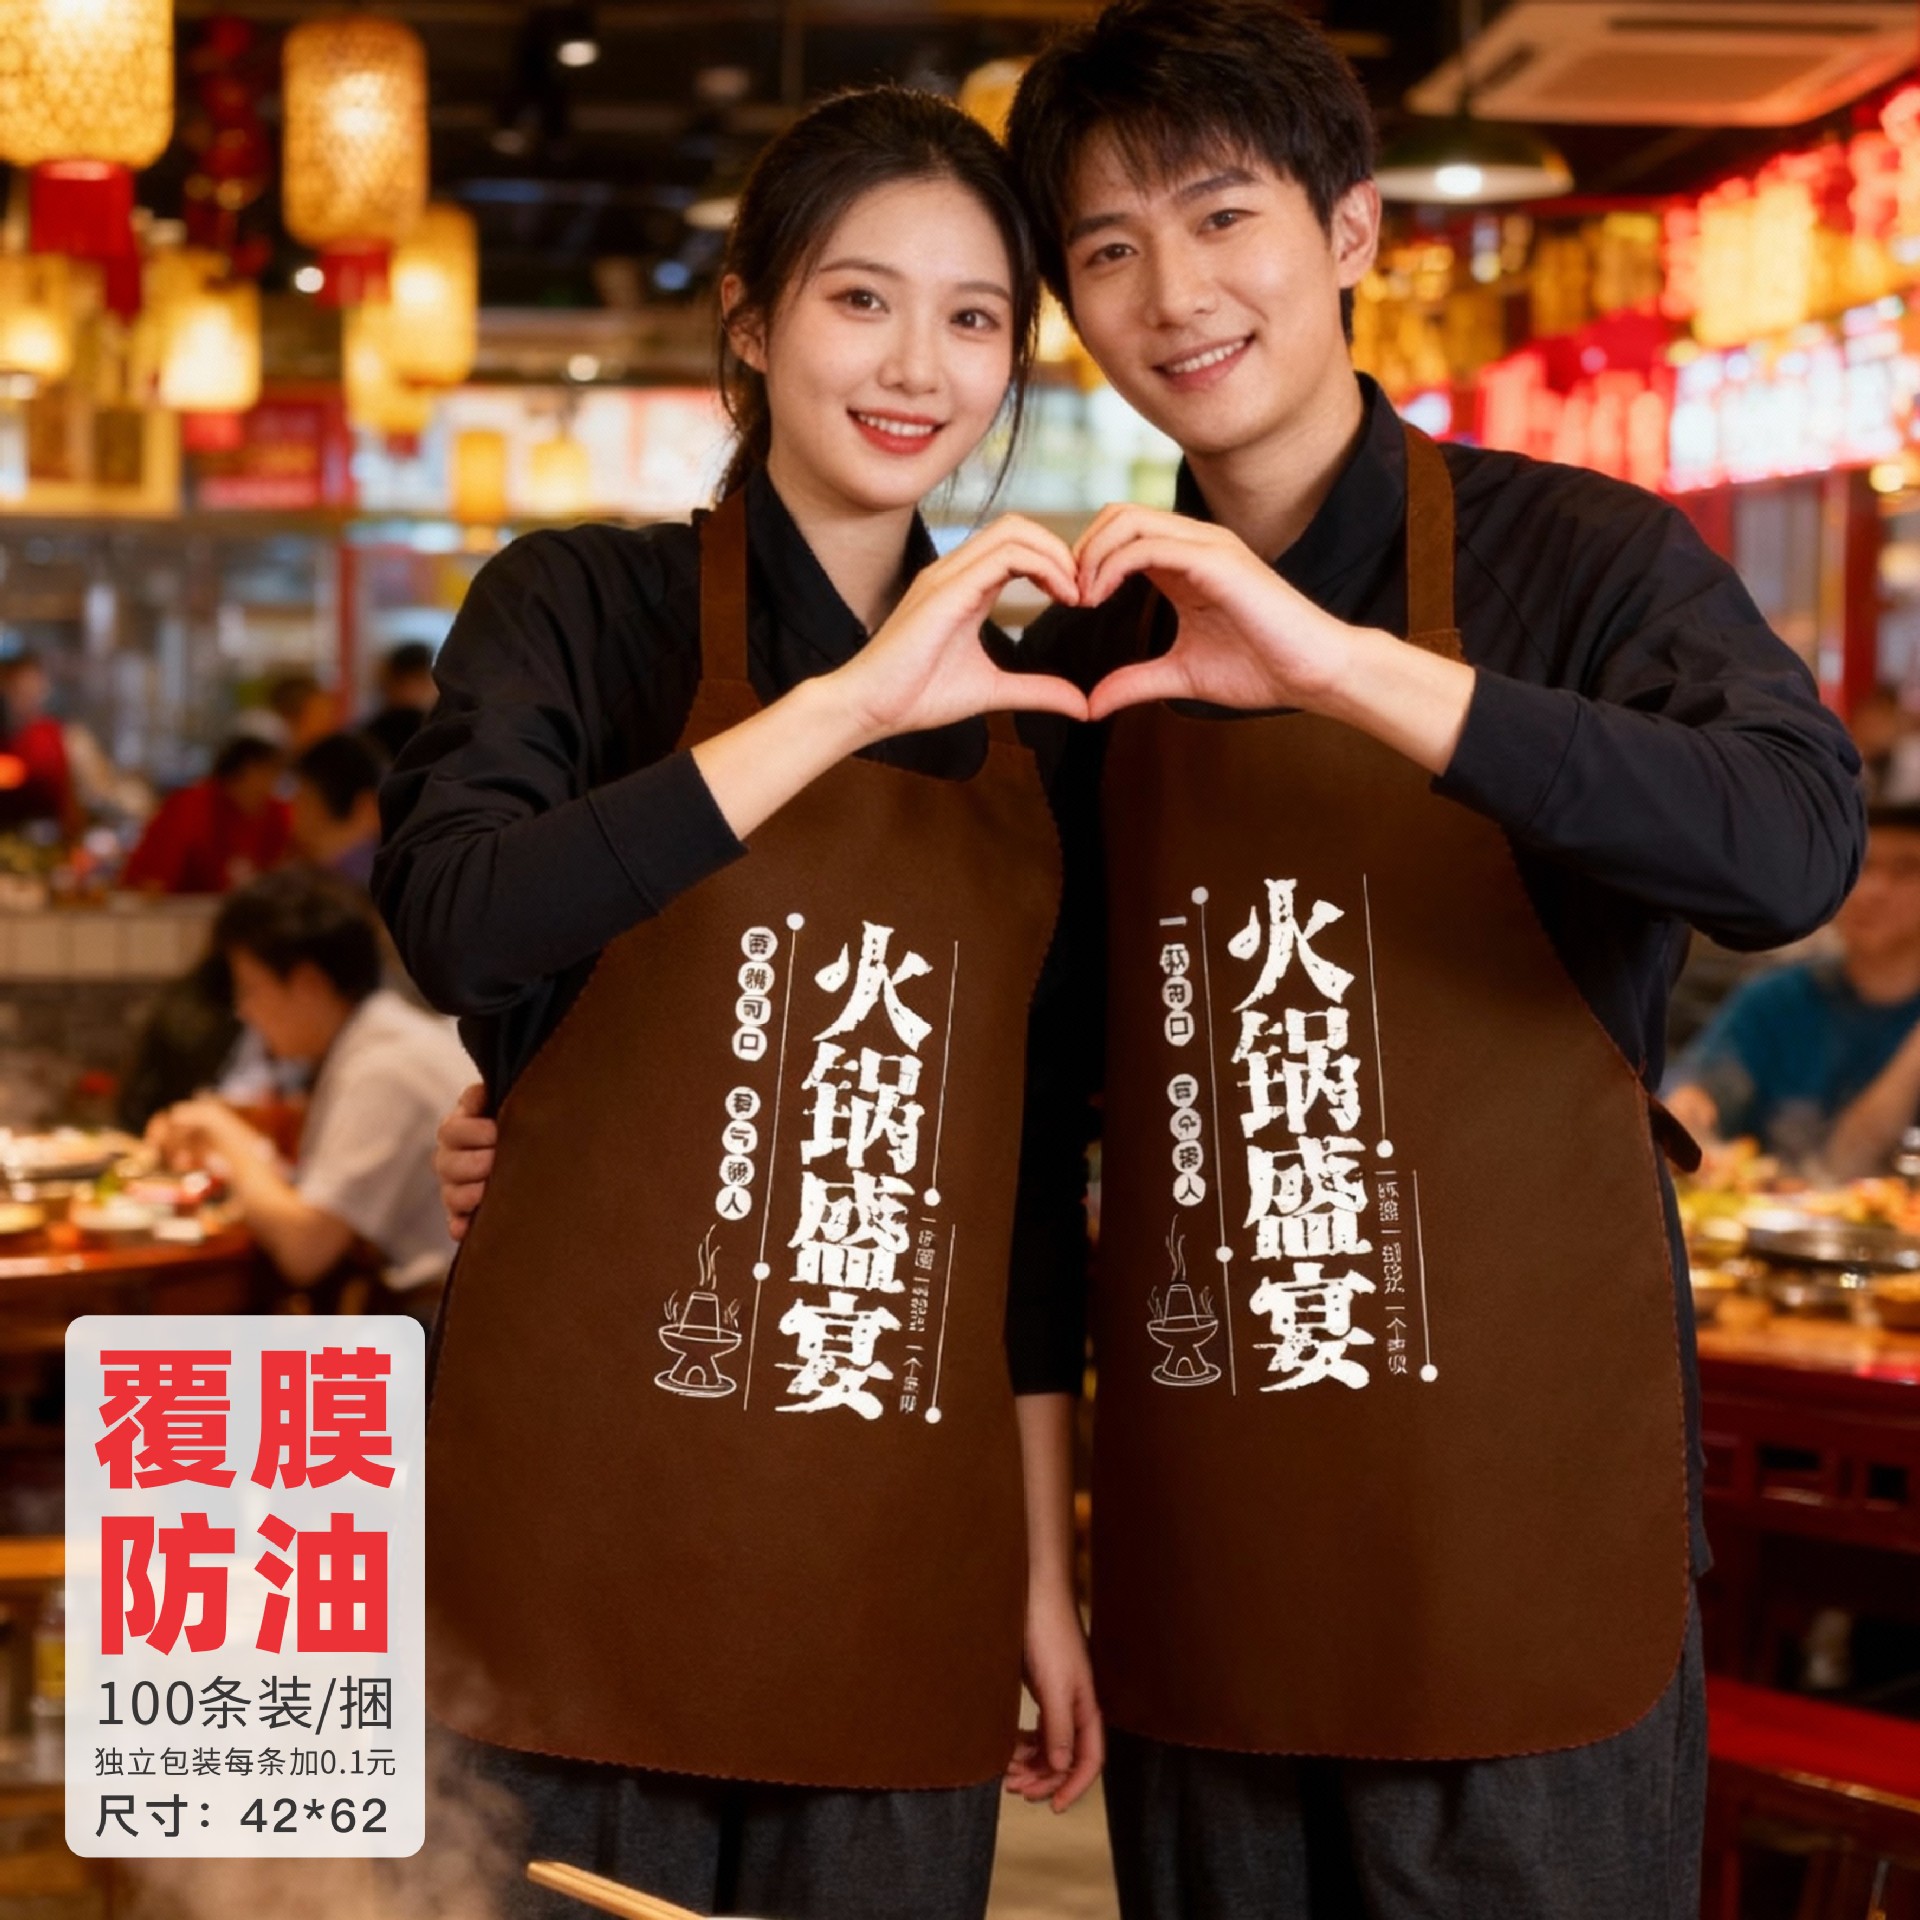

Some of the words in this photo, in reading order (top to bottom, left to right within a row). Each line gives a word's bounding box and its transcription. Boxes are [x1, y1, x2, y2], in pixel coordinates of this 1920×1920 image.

[774, 920, 933, 1421] 火锅盛宴
[1228, 878, 1376, 1393] 火锅盛宴
